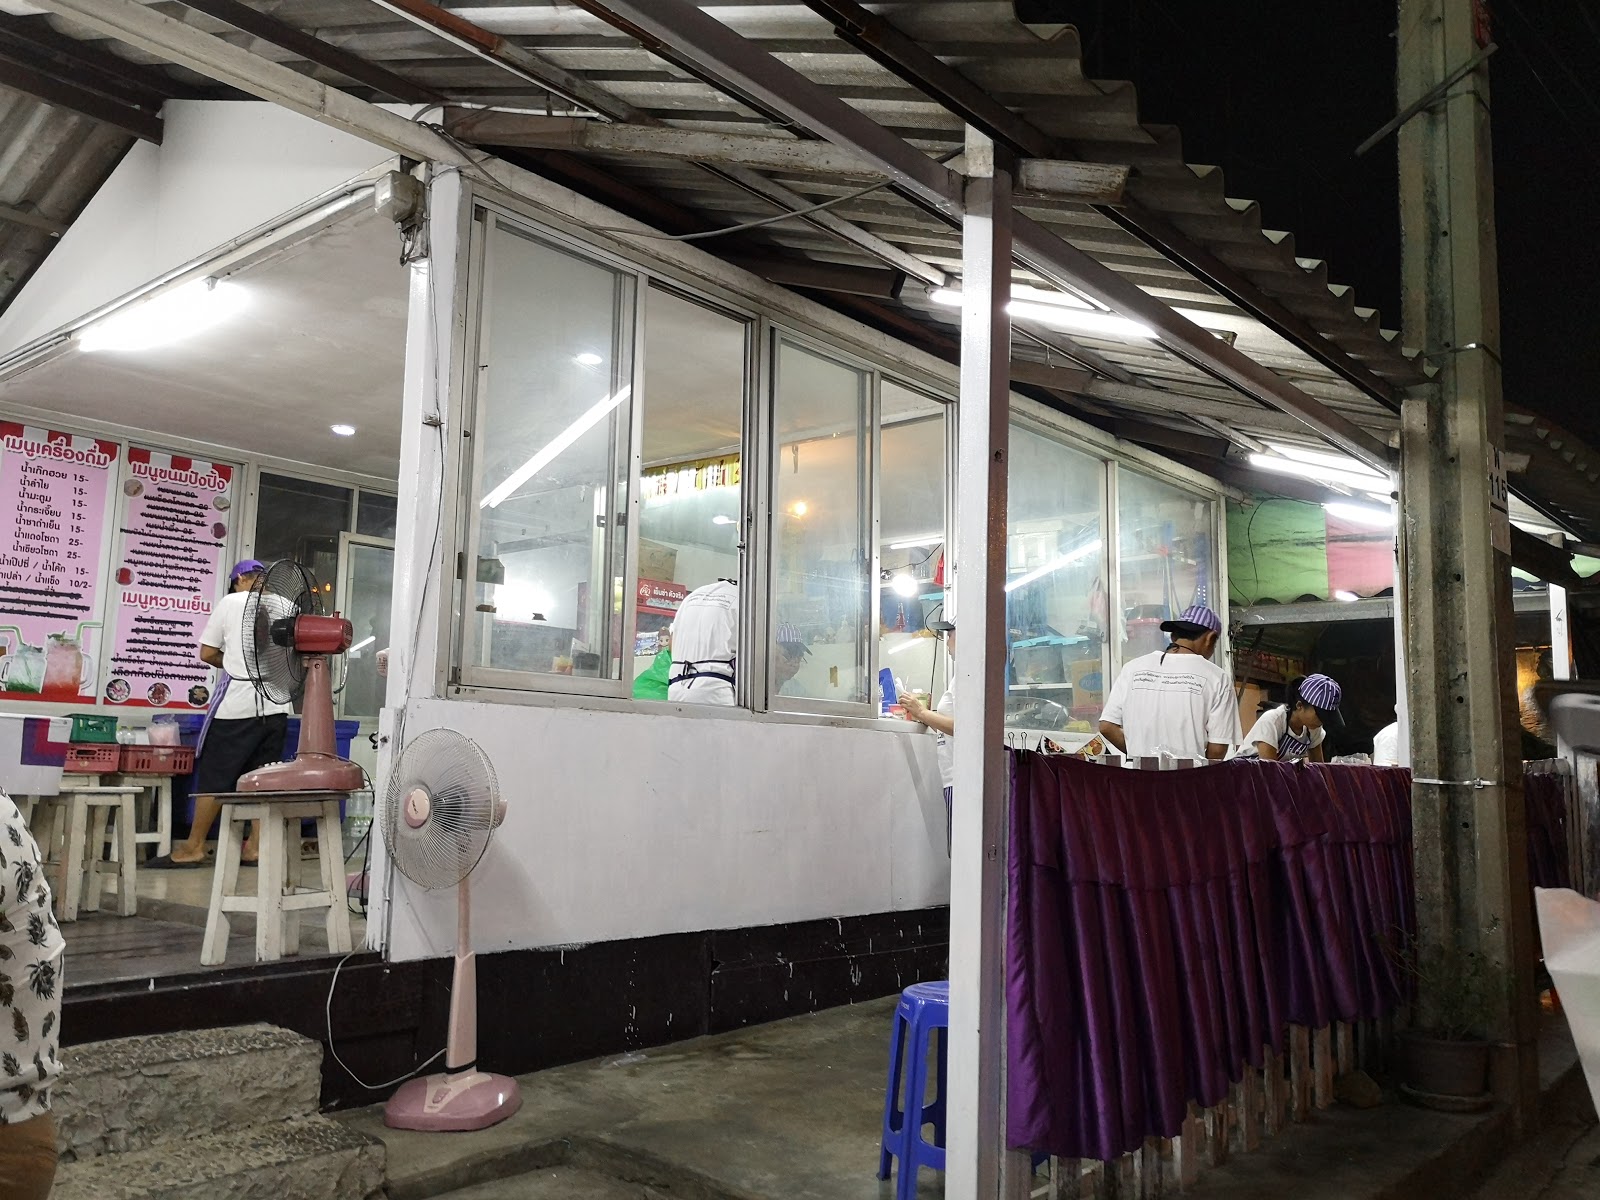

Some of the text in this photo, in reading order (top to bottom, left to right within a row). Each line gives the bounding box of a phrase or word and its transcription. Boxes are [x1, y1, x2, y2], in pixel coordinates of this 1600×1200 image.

[5, 436, 108, 466] เมนูเครื่องดื่ม
[21, 461, 68, 479] น้ำเก๊กฮวย
[132, 463, 225, 489] เมนูขนมปังปิ้ง
[20, 475, 50, 490] น้ำลำไย
[1489, 471, 1507, 503] 115
[15, 513, 61, 531] น้ำชาดำเย็น
[14, 527, 60, 544] น้ำแดงโซดา
[122, 591, 211, 613] เมนูหวานเย็น
